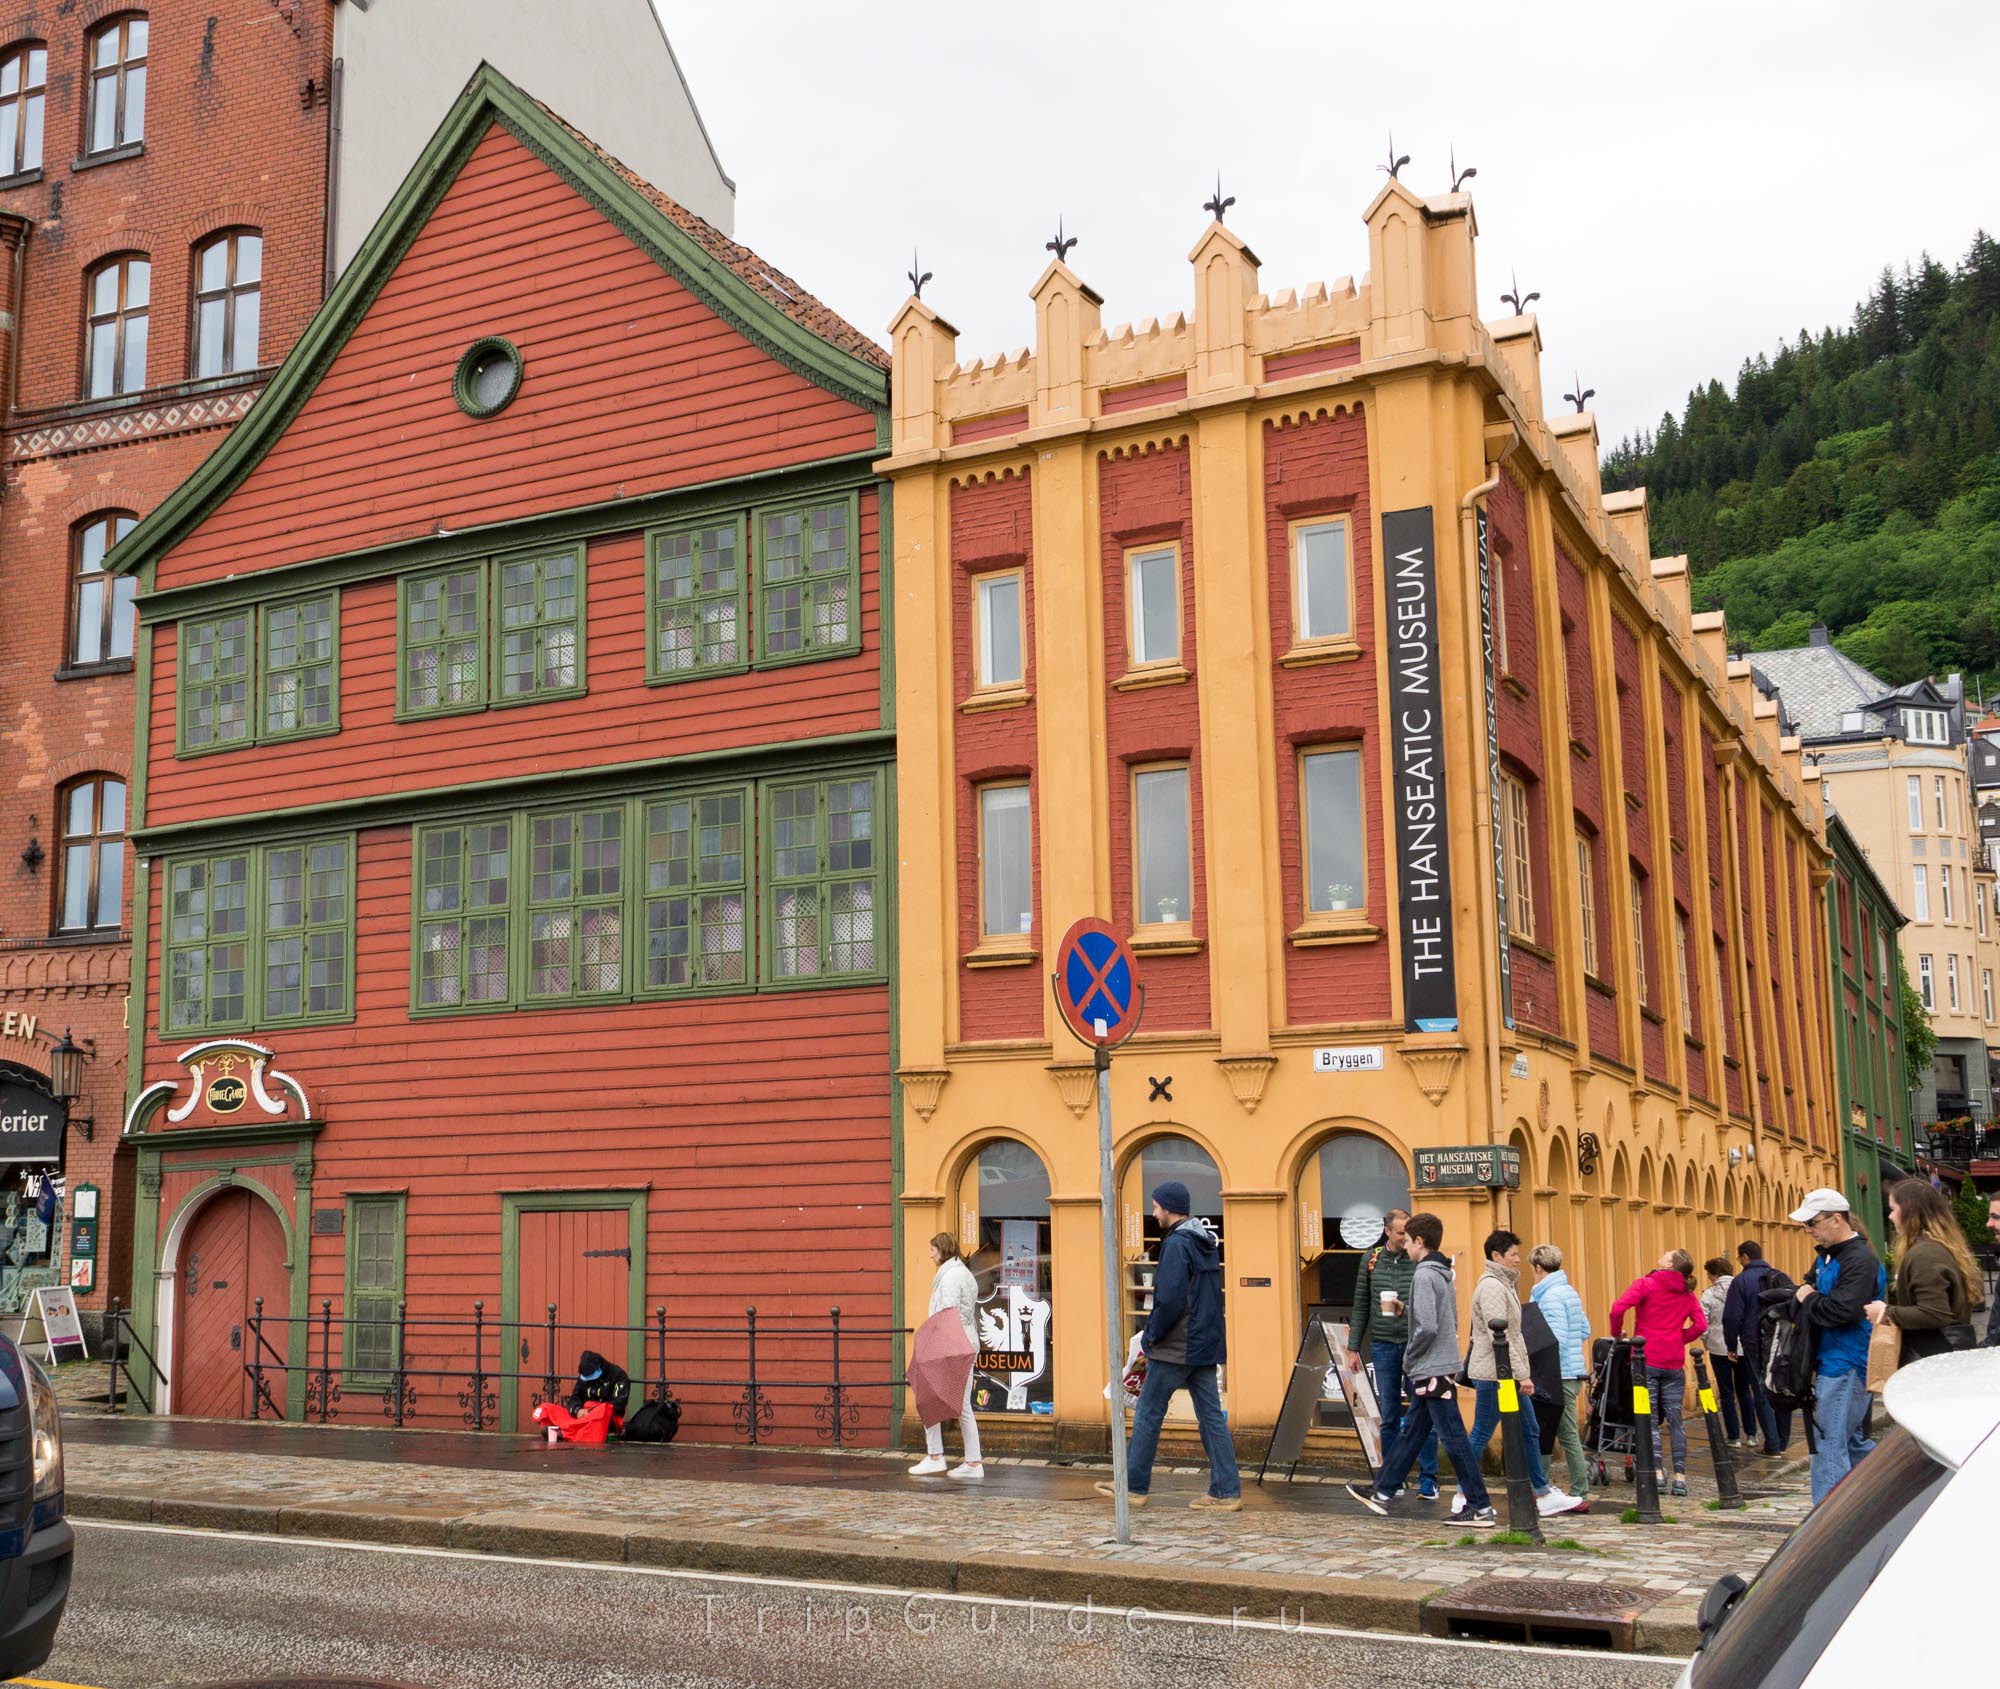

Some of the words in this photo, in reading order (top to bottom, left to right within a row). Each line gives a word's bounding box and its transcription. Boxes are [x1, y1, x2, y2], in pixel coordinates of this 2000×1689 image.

[1477, 519, 1493, 663] MUSEUM
[1394, 547, 1430, 694] MUSEUM
[1402, 709, 1440, 902] HANSEATIC
[1485, 674, 1505, 900] HANSEATISKE
[1412, 917, 1443, 981] THE
[1499, 913, 1511, 975] DET
[0, 1011, 37, 1039] EN
[1322, 1052, 1373, 1067] Bryggen
[0, 1109, 49, 1132] erier
[1420, 1153, 1434, 1164] DET
[1437, 1151, 1494, 1163] HANSEATISKE
[1440, 1164, 1473, 1175] MUSEUM
[975, 1354, 1032, 1369] USEUM
